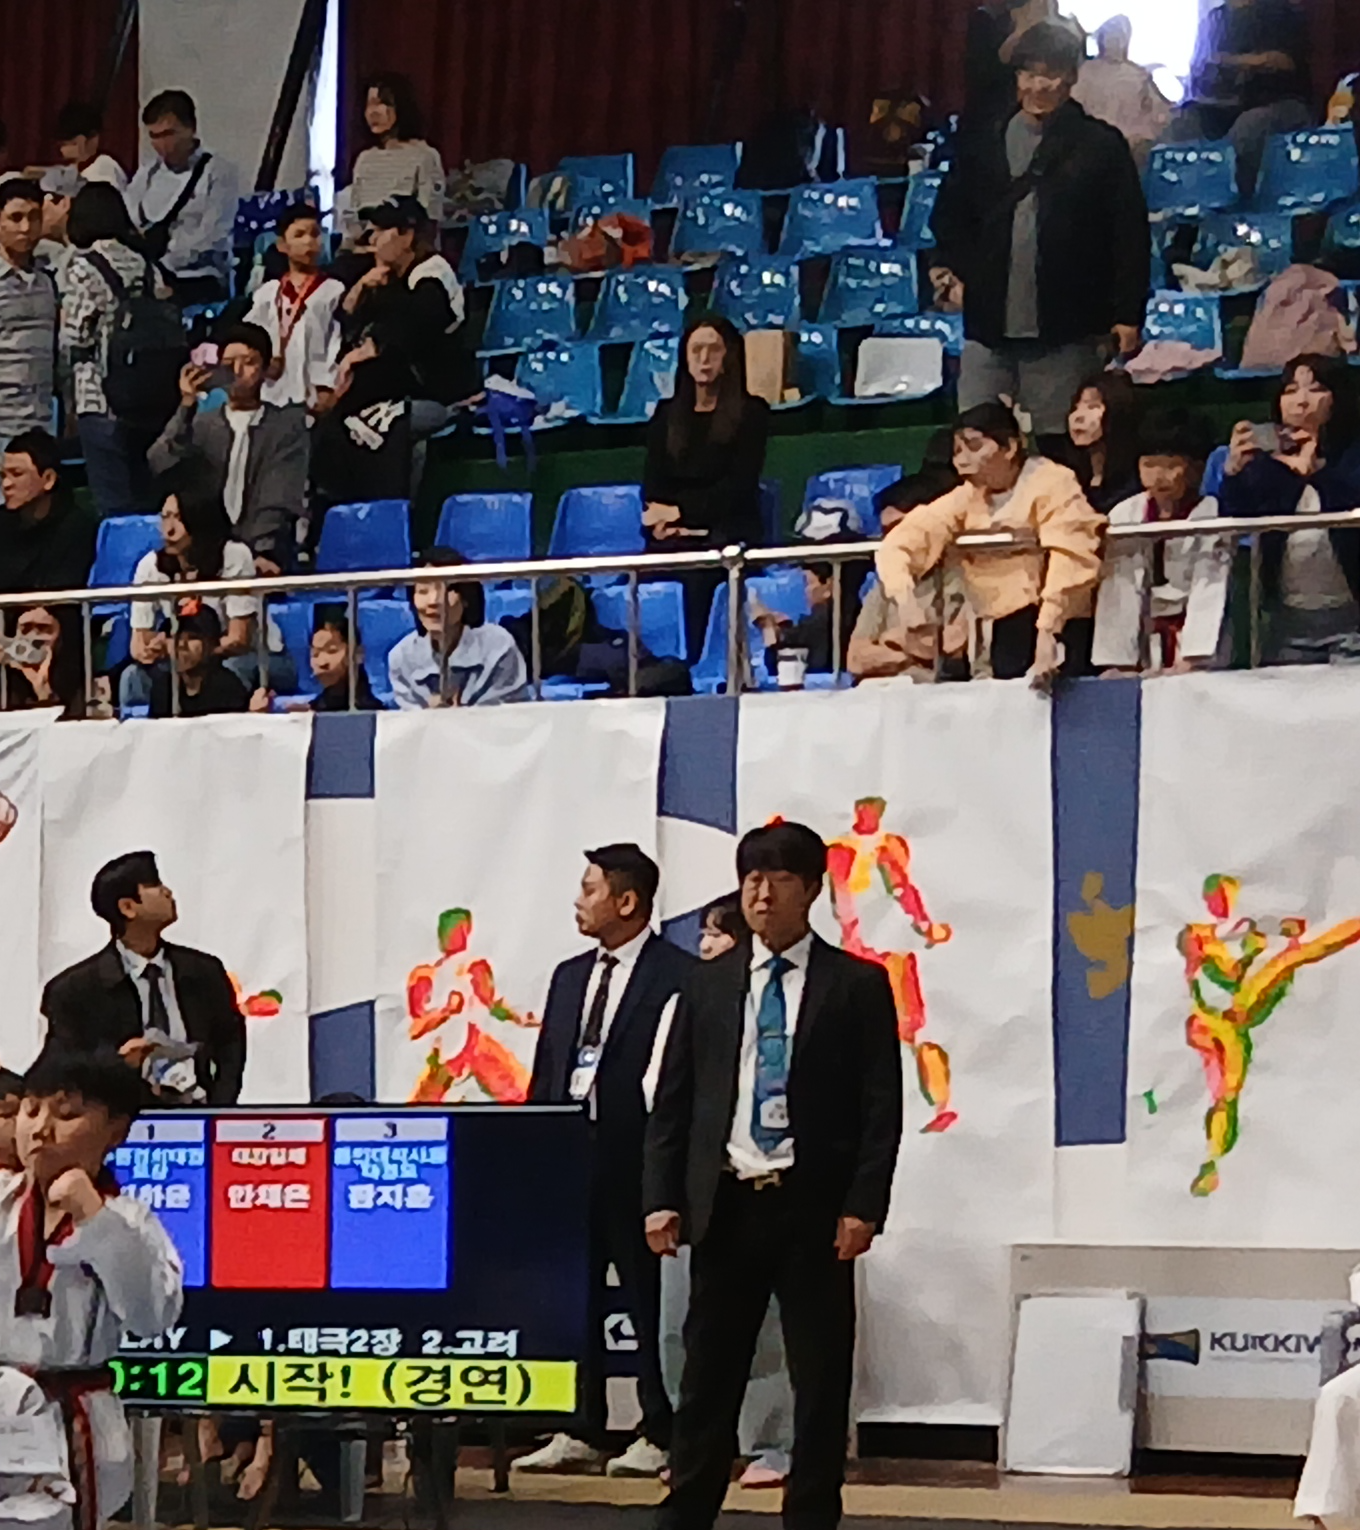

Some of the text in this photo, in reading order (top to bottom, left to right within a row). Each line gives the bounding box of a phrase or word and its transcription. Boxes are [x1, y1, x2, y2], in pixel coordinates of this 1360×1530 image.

[261, 1123, 276, 1140] 2
[383, 1122, 397, 1138] 3
[421, 1329, 521, 1358] 2.고려
[227, 1360, 352, 1403] 시작!
[382, 1360, 532, 1407] (경연)
